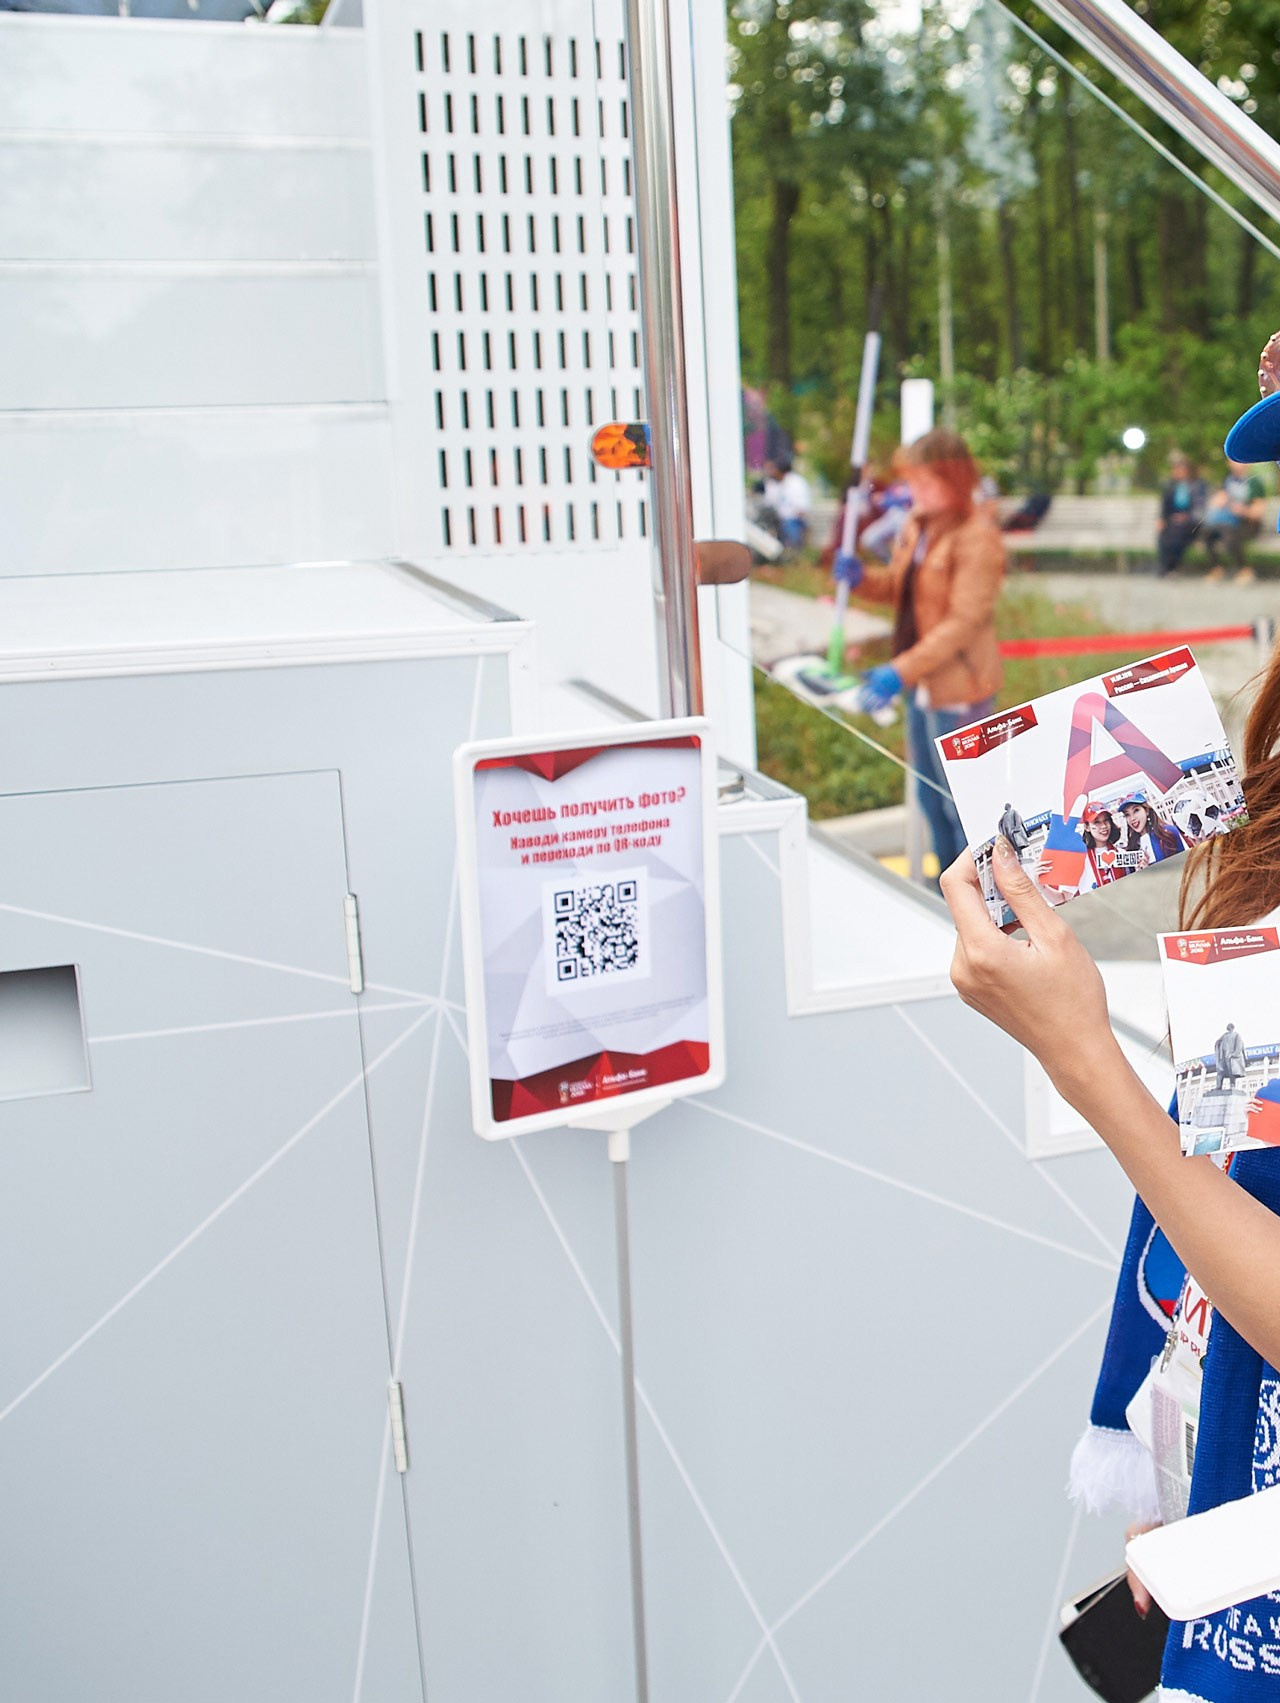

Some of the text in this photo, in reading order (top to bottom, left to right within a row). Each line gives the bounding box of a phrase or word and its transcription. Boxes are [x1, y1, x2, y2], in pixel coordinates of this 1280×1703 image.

[492, 786, 686, 827] Хочешь получить фото?
[510, 818, 670, 850] Наводи камеру телефона
[521, 834, 662, 865] и переходи по QR-коду
[1220, 935, 1264, 945] Альфа-Банк
